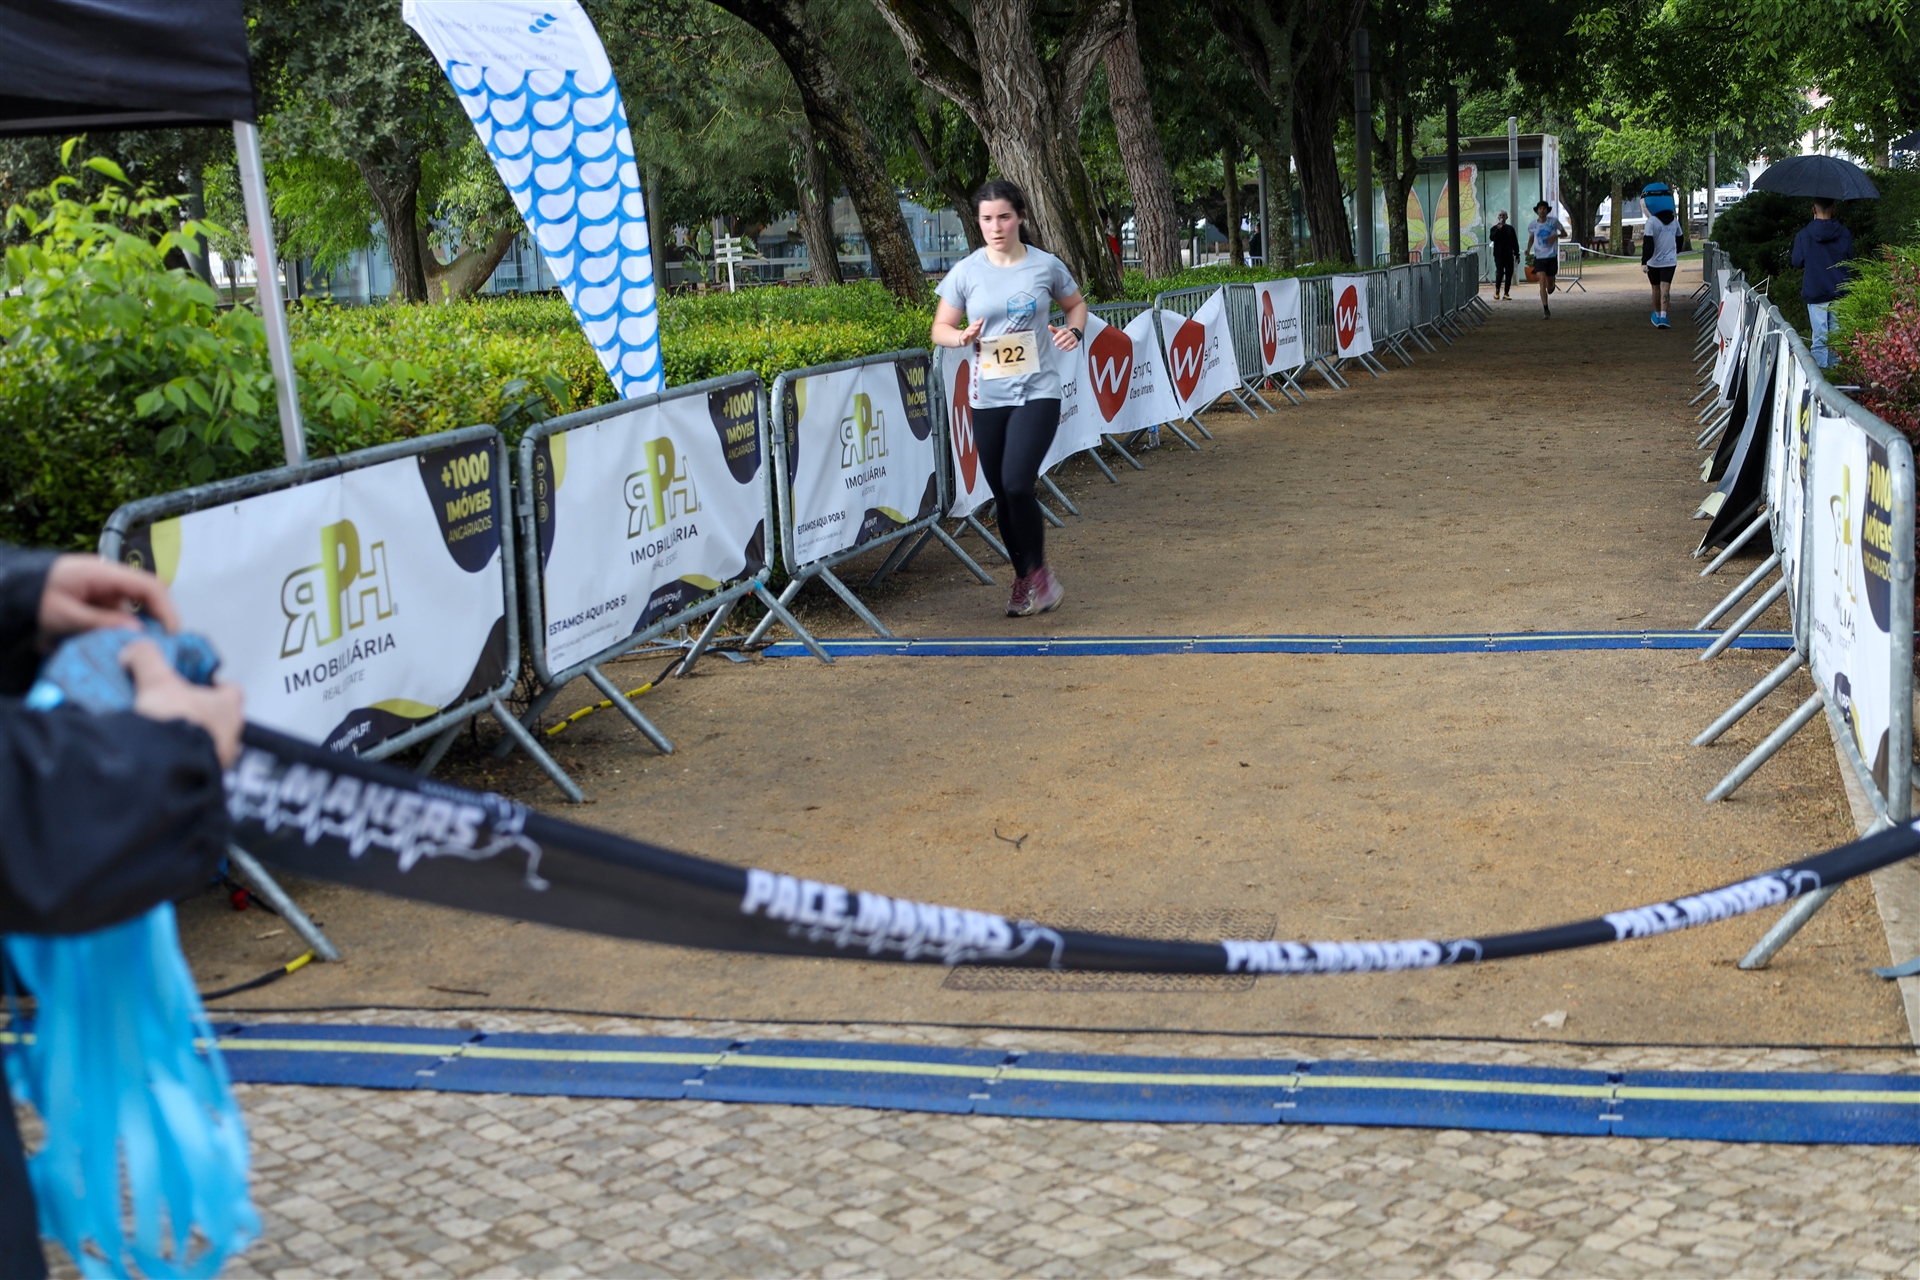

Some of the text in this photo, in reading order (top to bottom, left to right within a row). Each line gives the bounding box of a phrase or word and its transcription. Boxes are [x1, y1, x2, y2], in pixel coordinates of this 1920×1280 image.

[992, 346, 1025, 364] 122
[1173, 343, 1203, 381] W
[1091, 355, 1130, 394] W
[722, 390, 755, 419] +1000
[441, 450, 490, 490] +1000
[446, 488, 492, 523] IMÓVEIS
[828, 512, 840, 523] POR
[549, 611, 585, 636] ESTAMOS
[585, 603, 604, 619] AQUI
[605, 598, 620, 613] POR
[284, 633, 396, 694] IMOBILIÁRIA
[740, 867, 850, 927] PACE
